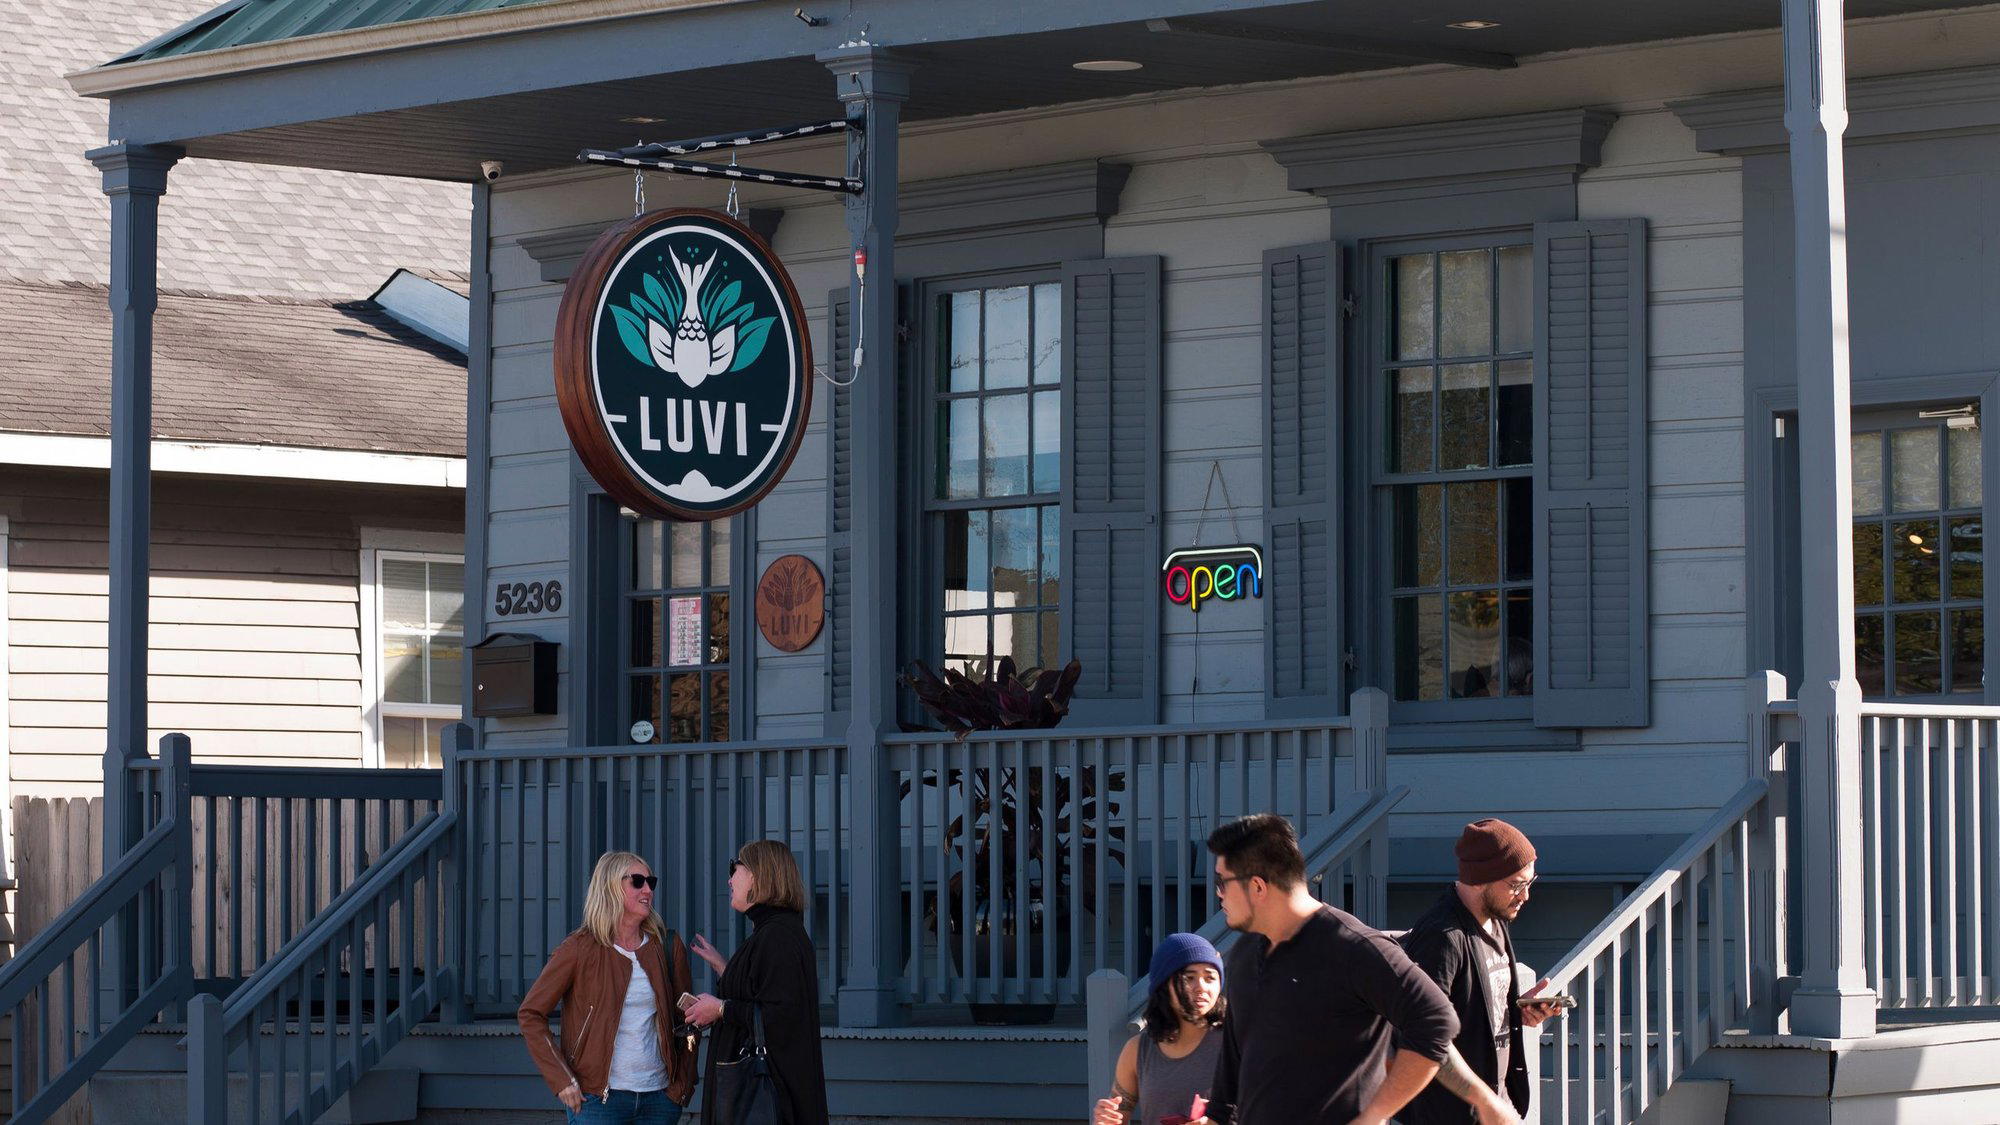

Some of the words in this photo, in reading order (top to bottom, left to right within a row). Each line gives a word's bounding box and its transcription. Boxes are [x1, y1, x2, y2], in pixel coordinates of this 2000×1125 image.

[640, 396, 748, 456] LUVI
[495, 580, 562, 616] 5236
[1166, 564, 1260, 611] open
[771, 614, 809, 636] LUVI
